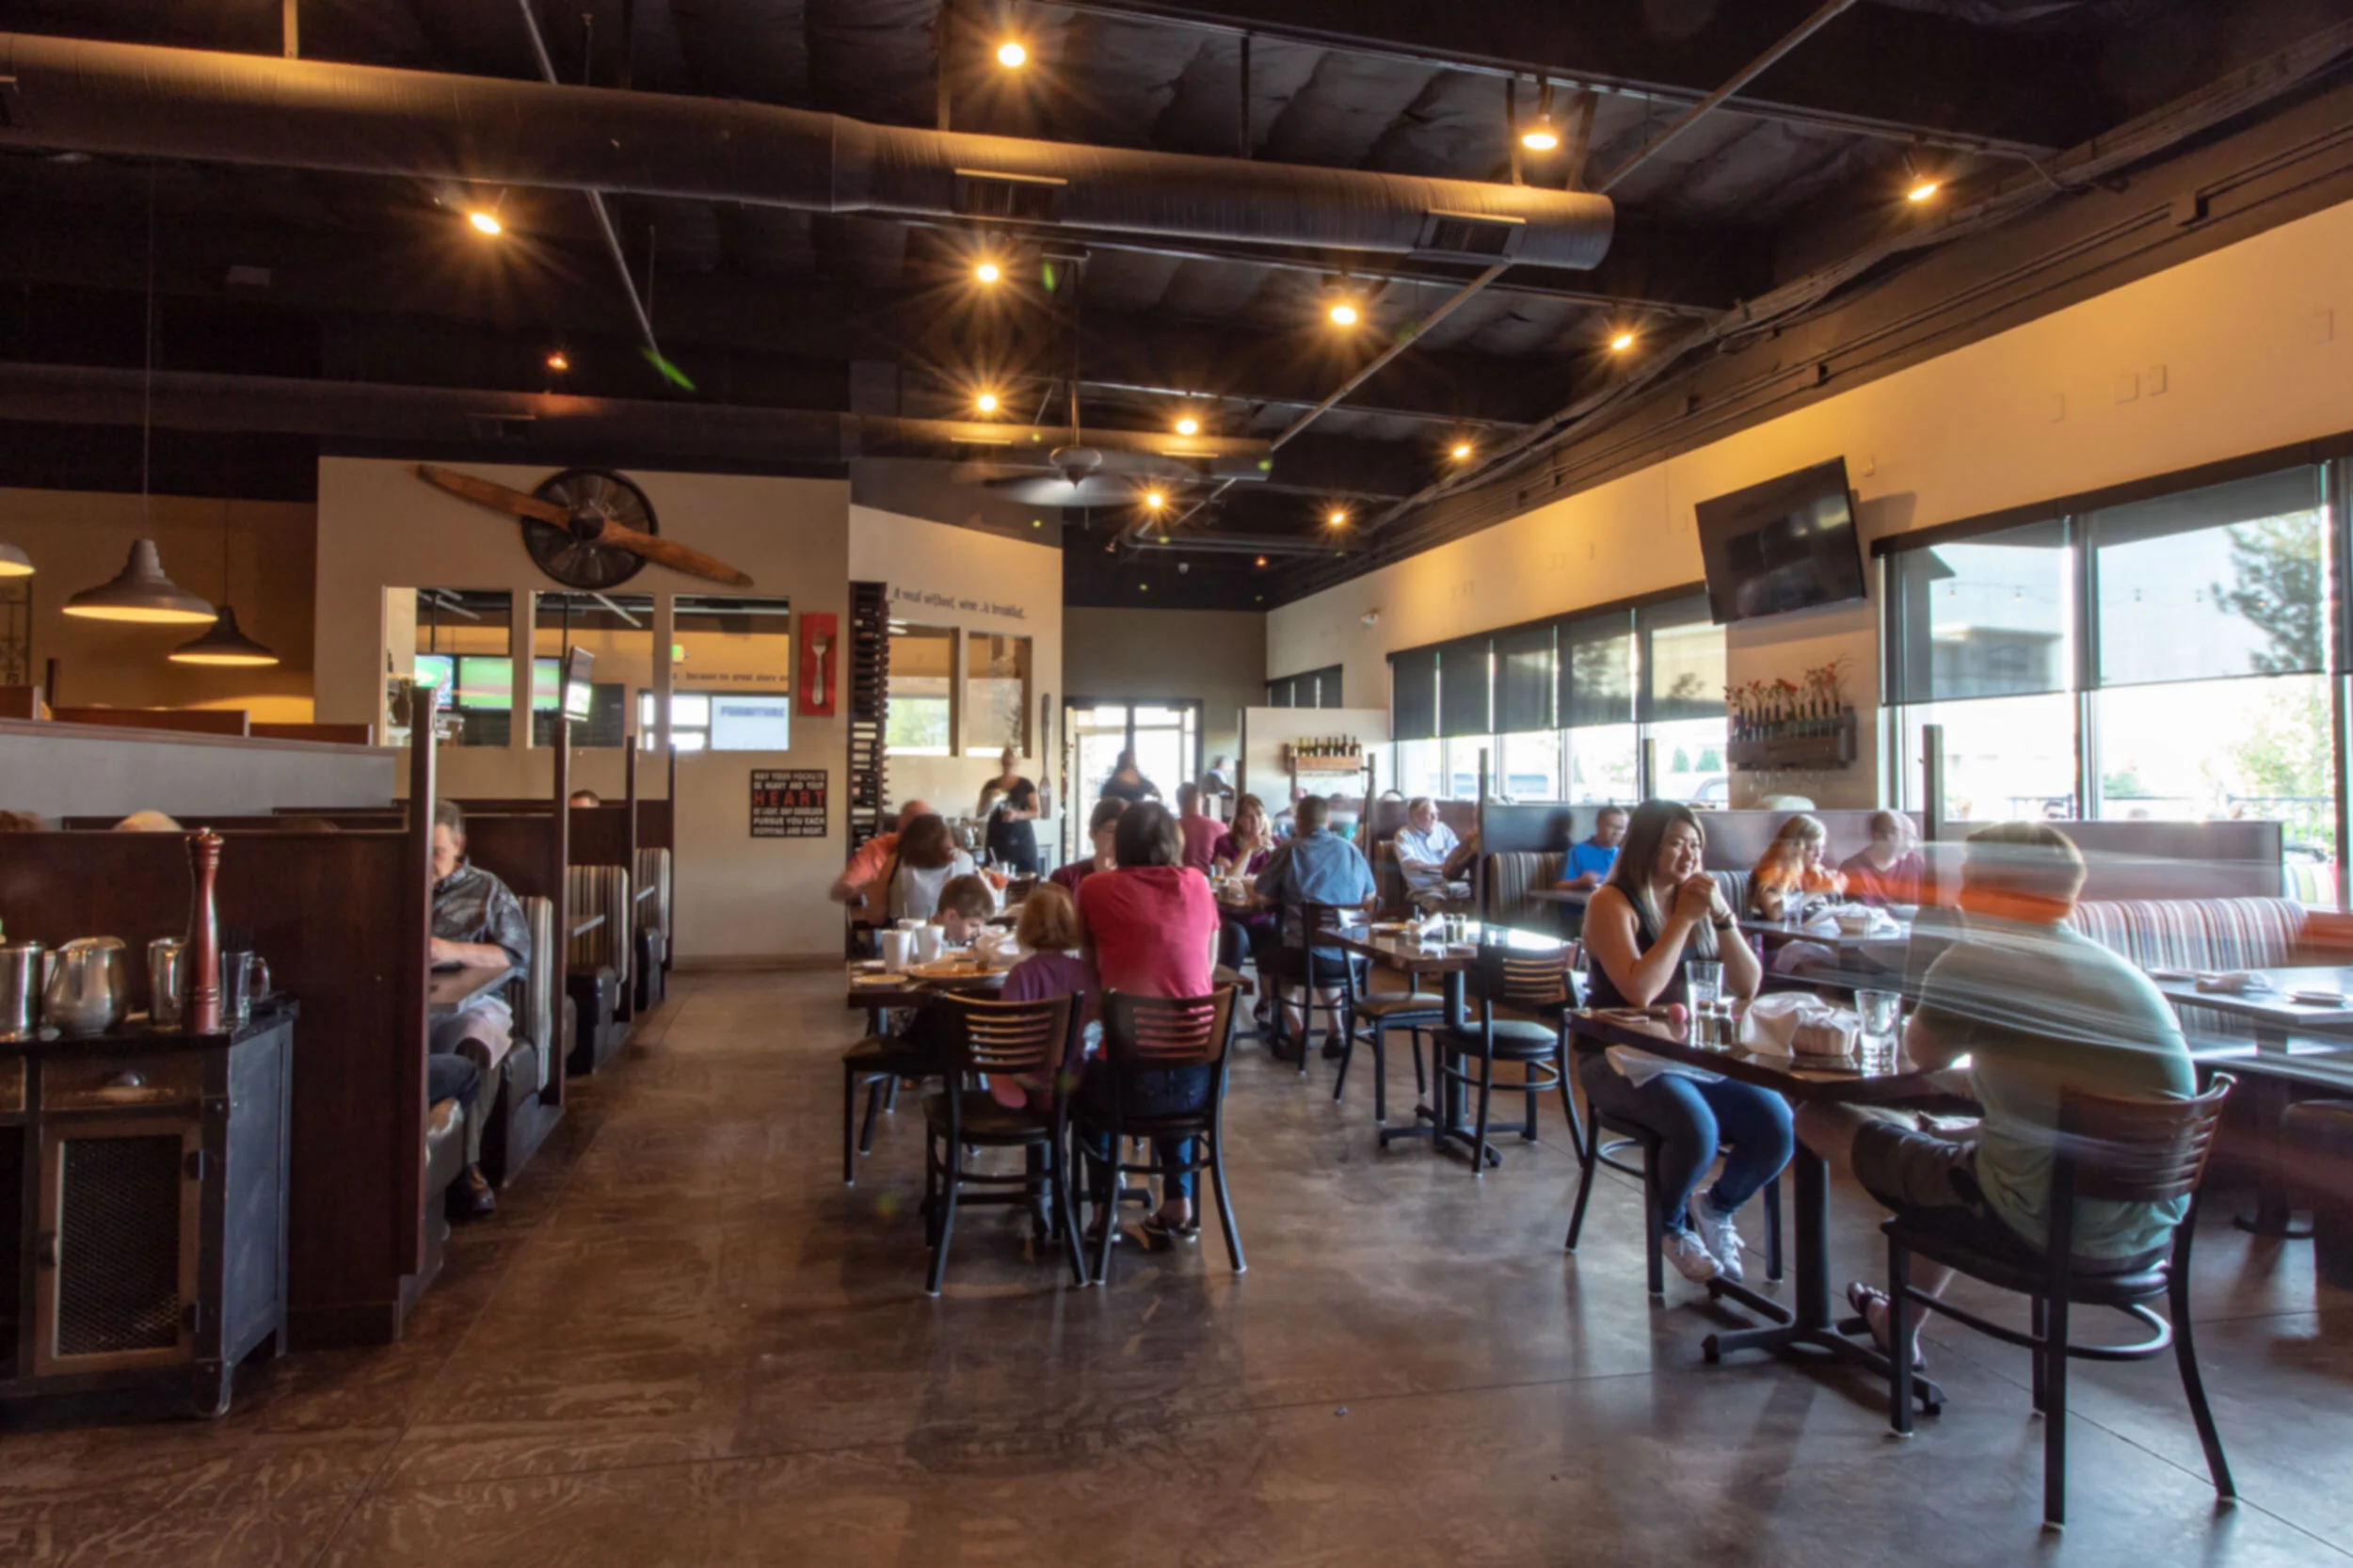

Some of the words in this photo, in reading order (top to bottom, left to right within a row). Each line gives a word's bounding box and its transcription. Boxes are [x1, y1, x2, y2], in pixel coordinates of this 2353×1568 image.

[958, 600, 978, 611] wine
[789, 781, 804, 790] AND
[806, 781, 824, 790] YOUR
[753, 790, 825, 807] HEART
[753, 816, 784, 825] PURSUE
[787, 816, 802, 825] YOU
[805, 816, 824, 825] EACH
